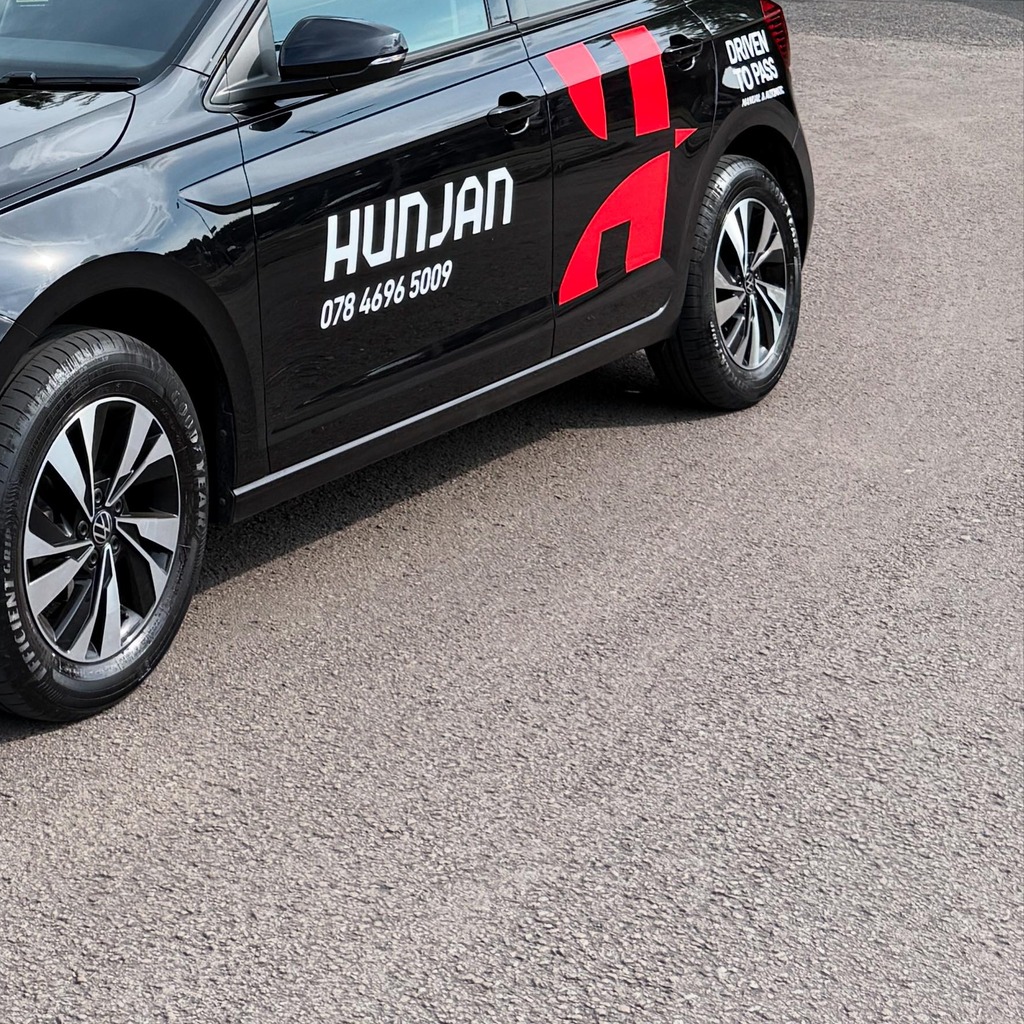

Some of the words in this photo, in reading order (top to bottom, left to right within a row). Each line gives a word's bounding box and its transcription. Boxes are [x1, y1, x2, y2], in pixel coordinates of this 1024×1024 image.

[725, 29, 769, 65] DRIVEN
[732, 65, 754, 92] TO
[750, 56, 779, 85] PASS
[324, 166, 514, 283] HUNJAN
[320, 292, 356, 329] 078
[358, 275, 406, 315] 4696
[408, 260, 453, 299] 5009
[4, 578, 48, 681] EFFICIENT
